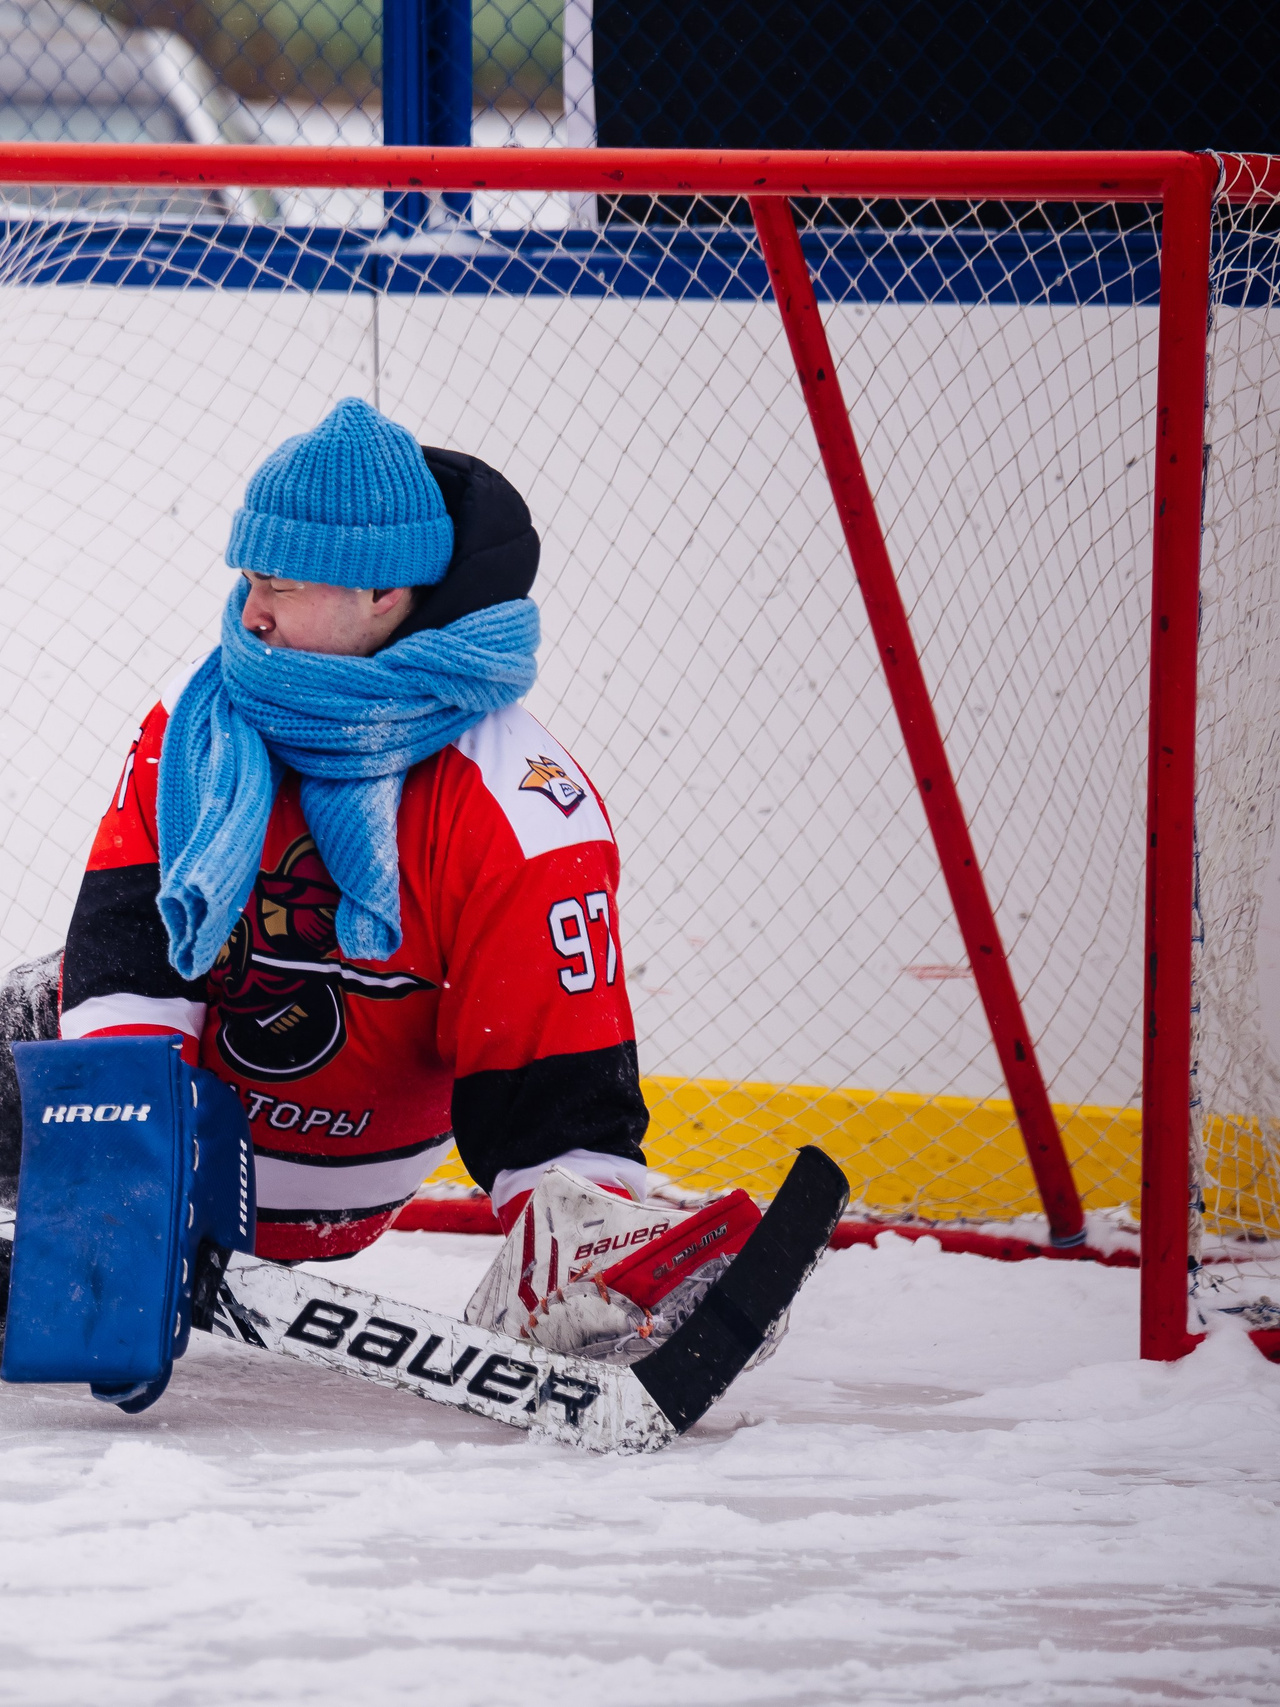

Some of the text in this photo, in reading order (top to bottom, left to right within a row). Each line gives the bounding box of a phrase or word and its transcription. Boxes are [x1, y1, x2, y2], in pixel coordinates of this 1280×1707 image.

[547, 890, 617, 996] 97
[42, 1104, 151, 1123] KROK
[229, 1085, 372, 1137] ТОРЫ
